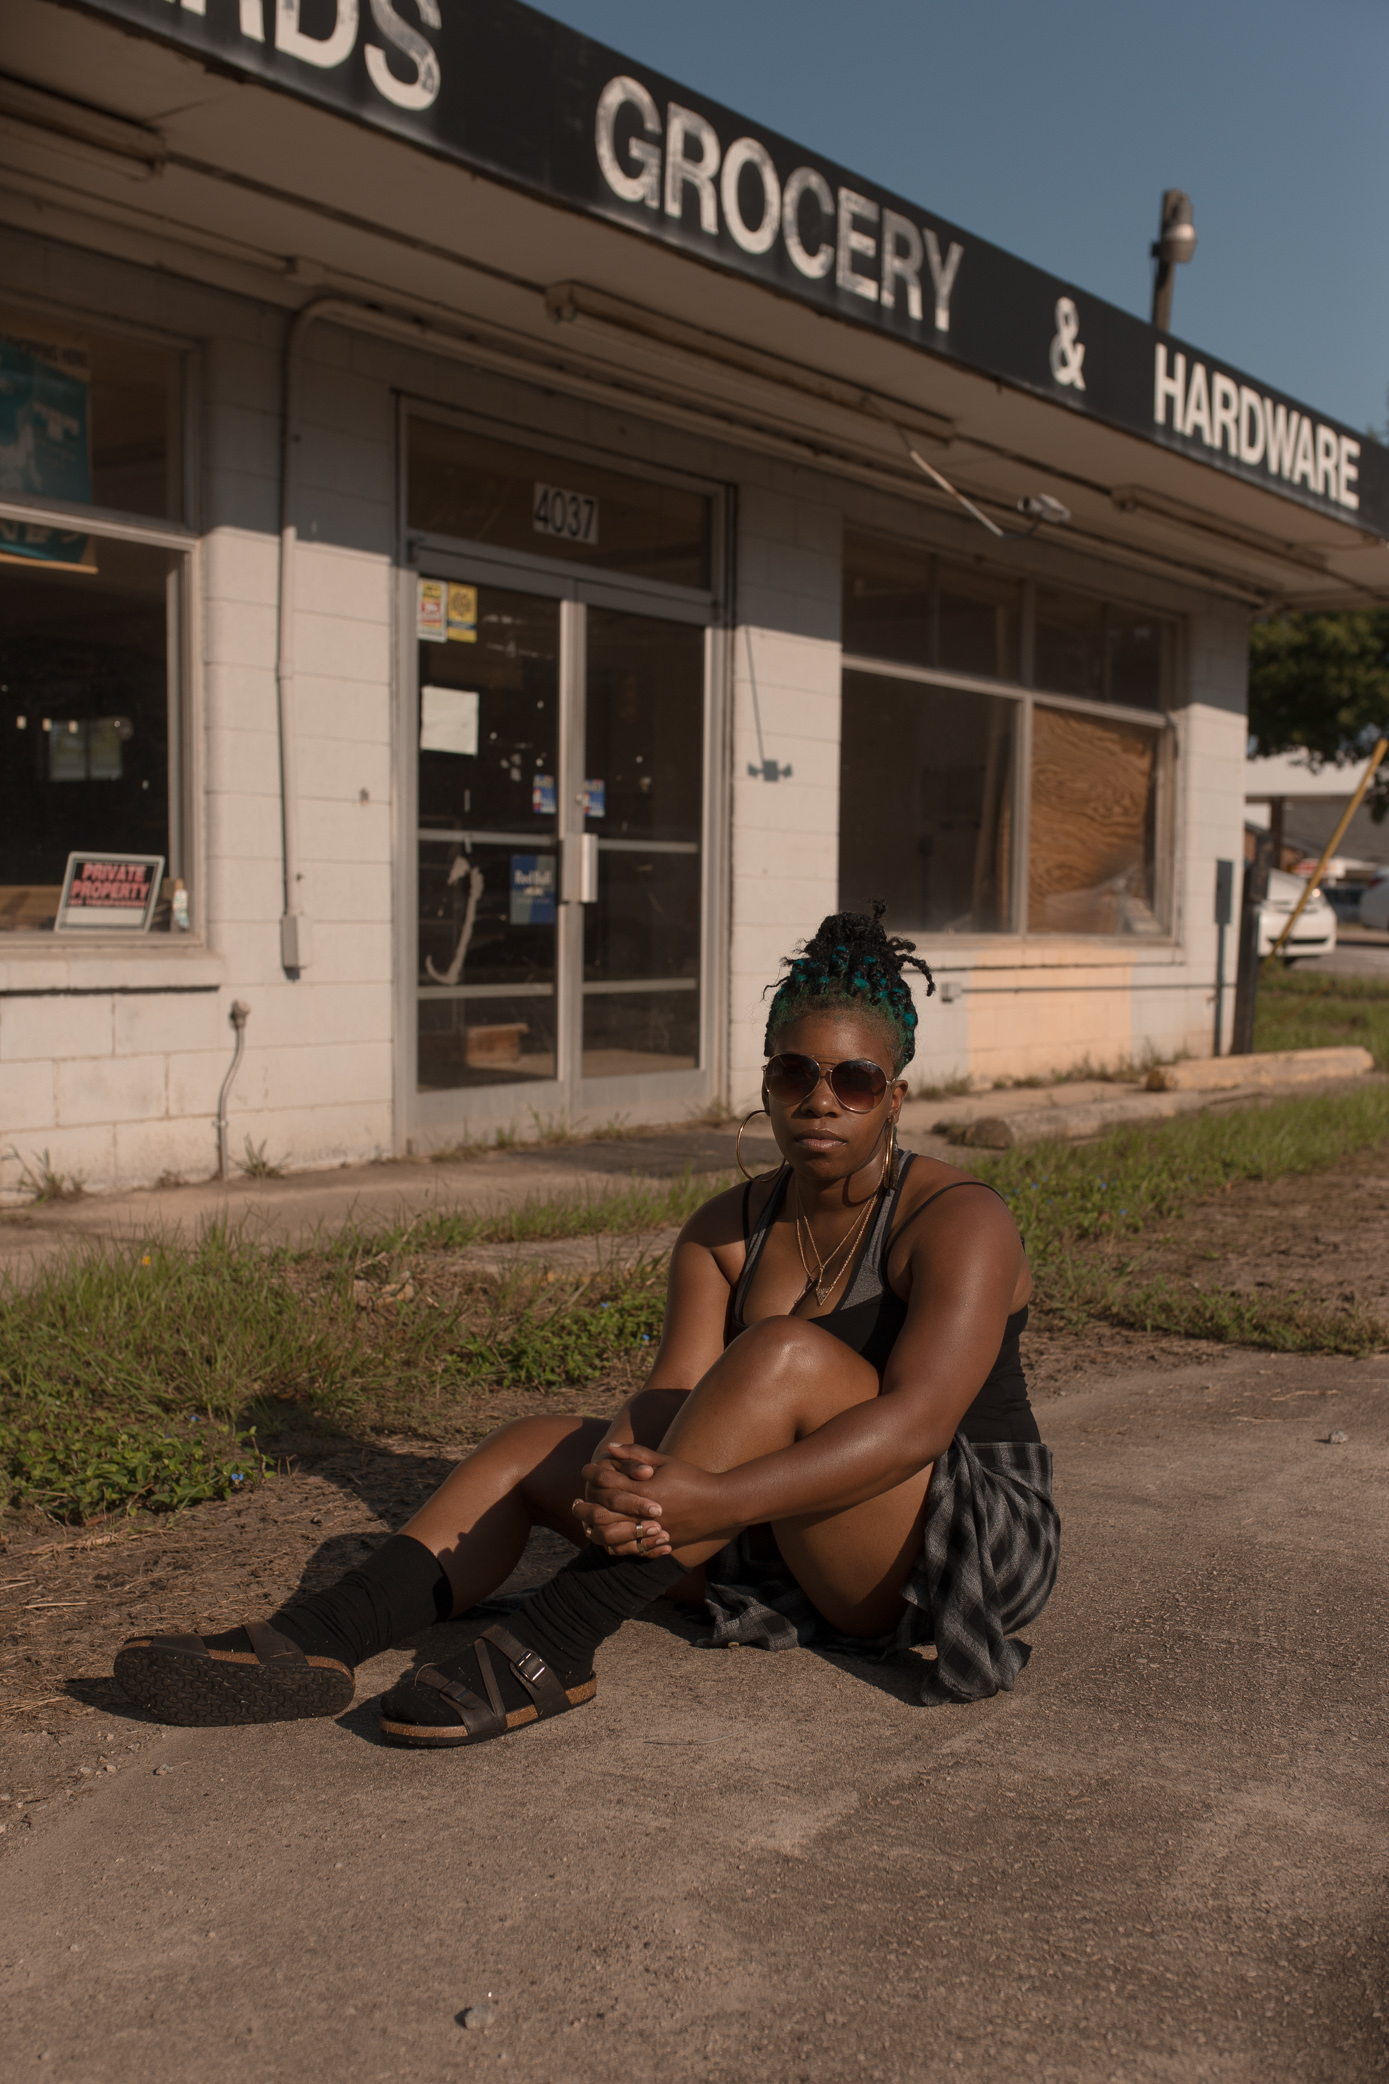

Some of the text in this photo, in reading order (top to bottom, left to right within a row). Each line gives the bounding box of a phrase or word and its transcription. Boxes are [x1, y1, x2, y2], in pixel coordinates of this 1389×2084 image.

[595, 75, 964, 332] GROCERY
[1051, 296, 1086, 391] &
[1154, 342, 1361, 510] HARDWARE
[534, 488, 595, 539] 4037
[82, 862, 147, 881] PRIVATE
[71, 880, 150, 899] PROPERTY
